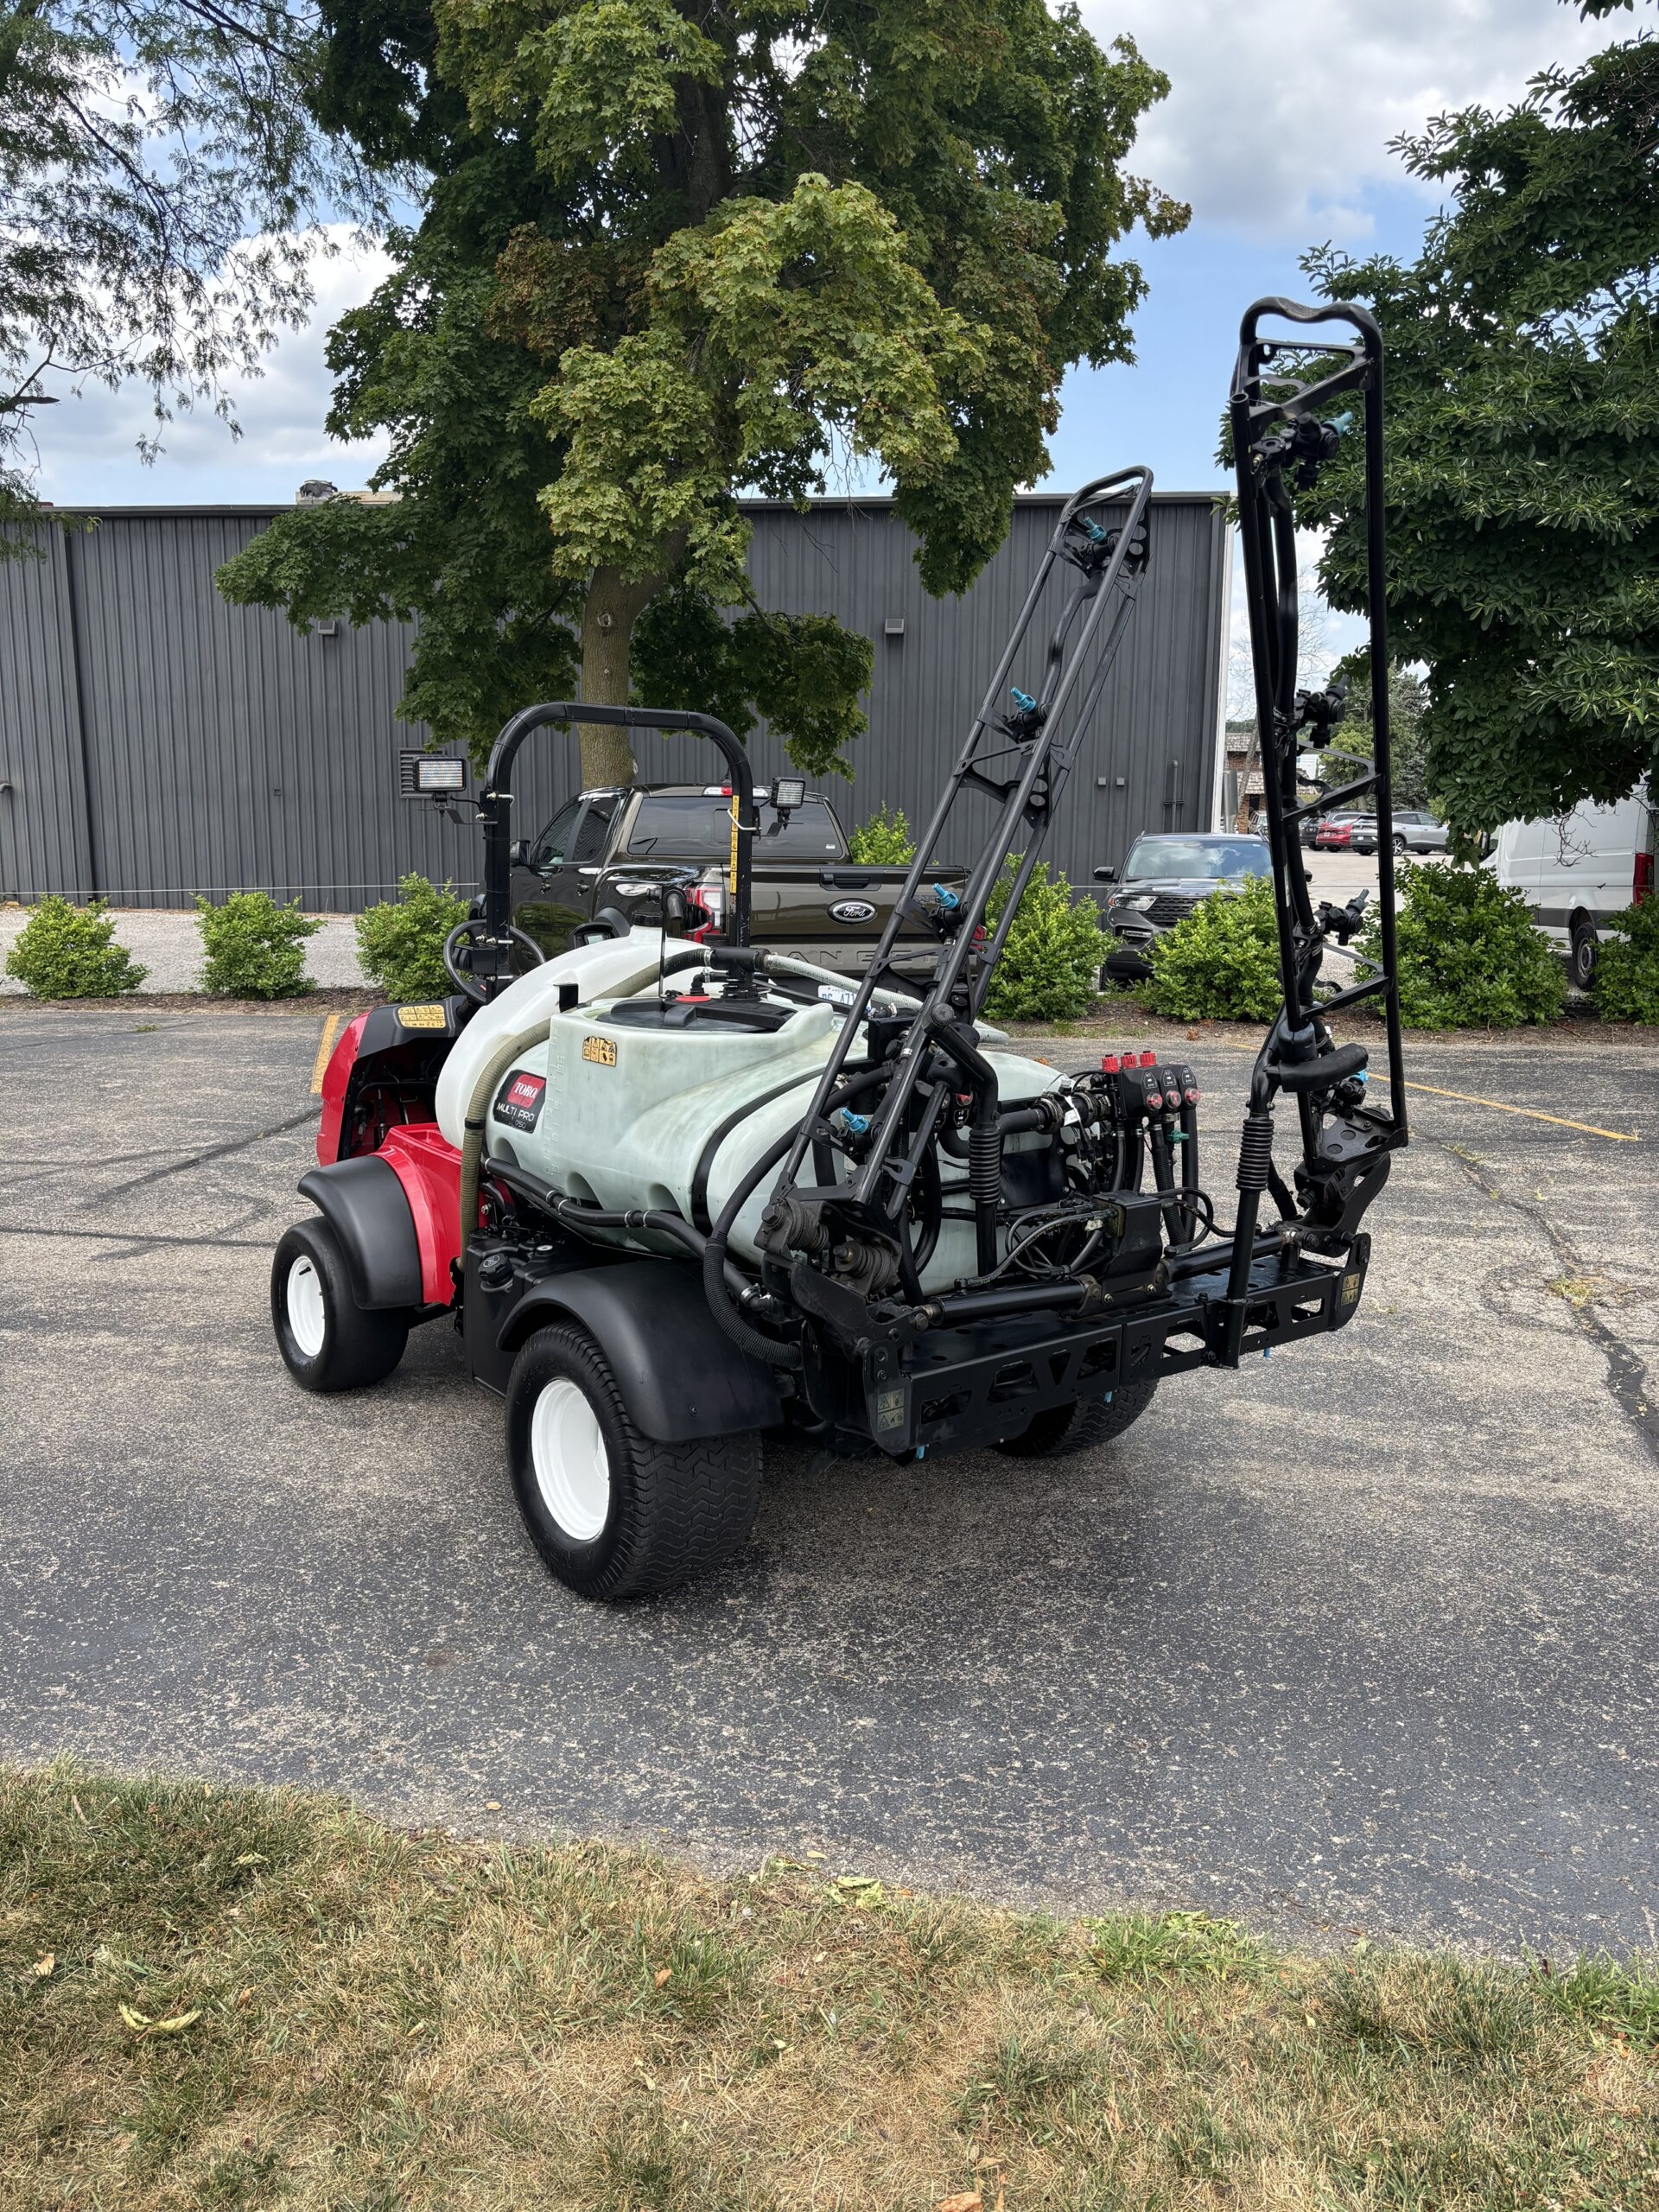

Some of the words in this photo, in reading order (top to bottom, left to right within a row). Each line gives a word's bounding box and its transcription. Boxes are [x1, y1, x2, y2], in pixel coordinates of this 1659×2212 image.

[843, 906, 866, 917] Ford
[514, 1082, 537, 1099] TORO
[496, 1102, 518, 1116] MULTI
[518, 1109, 535, 1122] PRO
